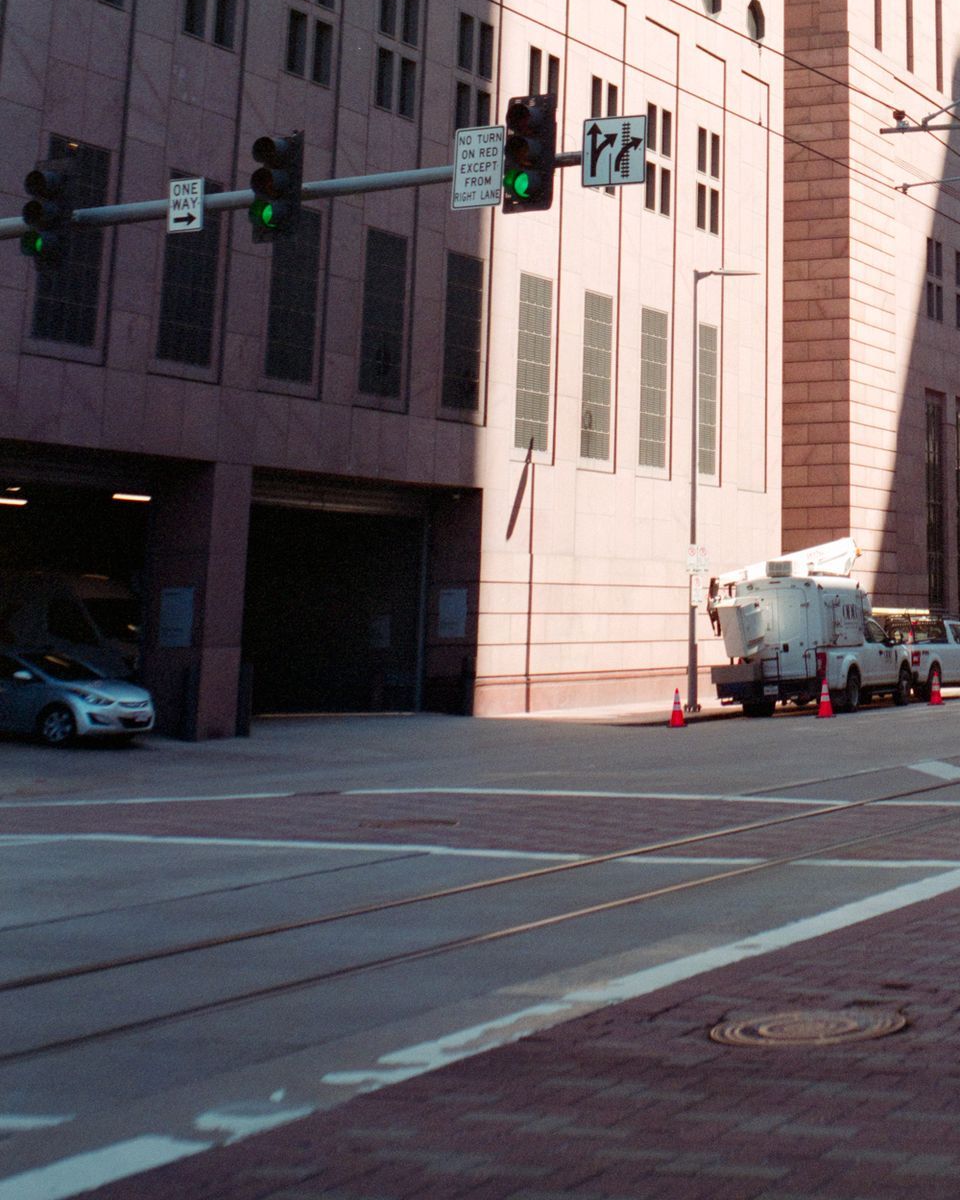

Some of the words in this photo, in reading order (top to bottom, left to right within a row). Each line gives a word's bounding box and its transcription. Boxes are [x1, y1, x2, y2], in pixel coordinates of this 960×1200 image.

[459, 135, 472, 146] NO
[477, 132, 502, 144] TURN
[462, 150, 475, 160] ON
[480, 147, 498, 158] RED
[460, 161, 498, 174] EXCEPT
[465, 176, 492, 187] FROM
[173, 182, 198, 197] ONE
[455, 191, 476, 202] RIGHT
[480, 188, 500, 200] LANE
[173, 197, 198, 210] WAY
